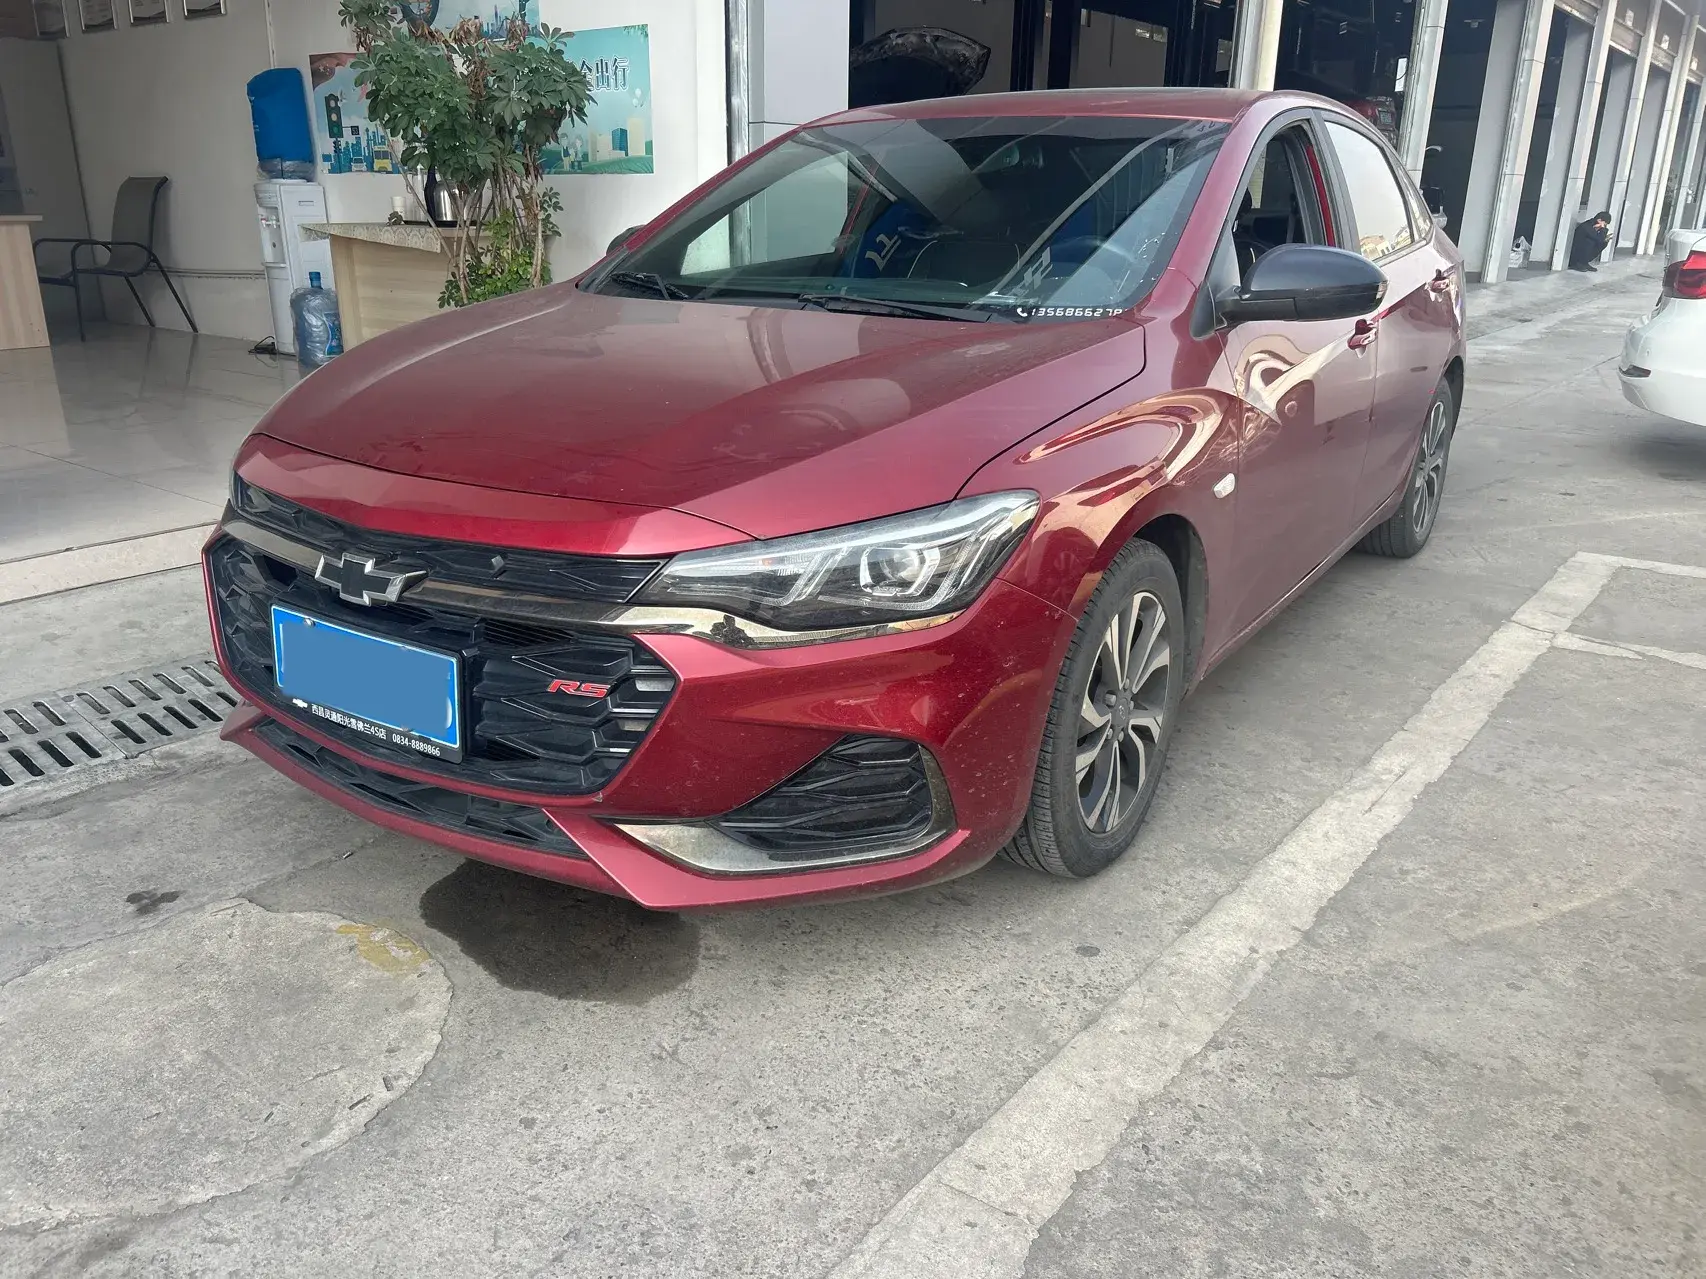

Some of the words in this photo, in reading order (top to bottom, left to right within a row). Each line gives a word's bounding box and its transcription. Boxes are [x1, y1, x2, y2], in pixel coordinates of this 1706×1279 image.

[1031, 307, 1128, 318] 1356866278
[547, 678, 611, 698] RS
[392, 732, 441, 757] 0834-8889866
